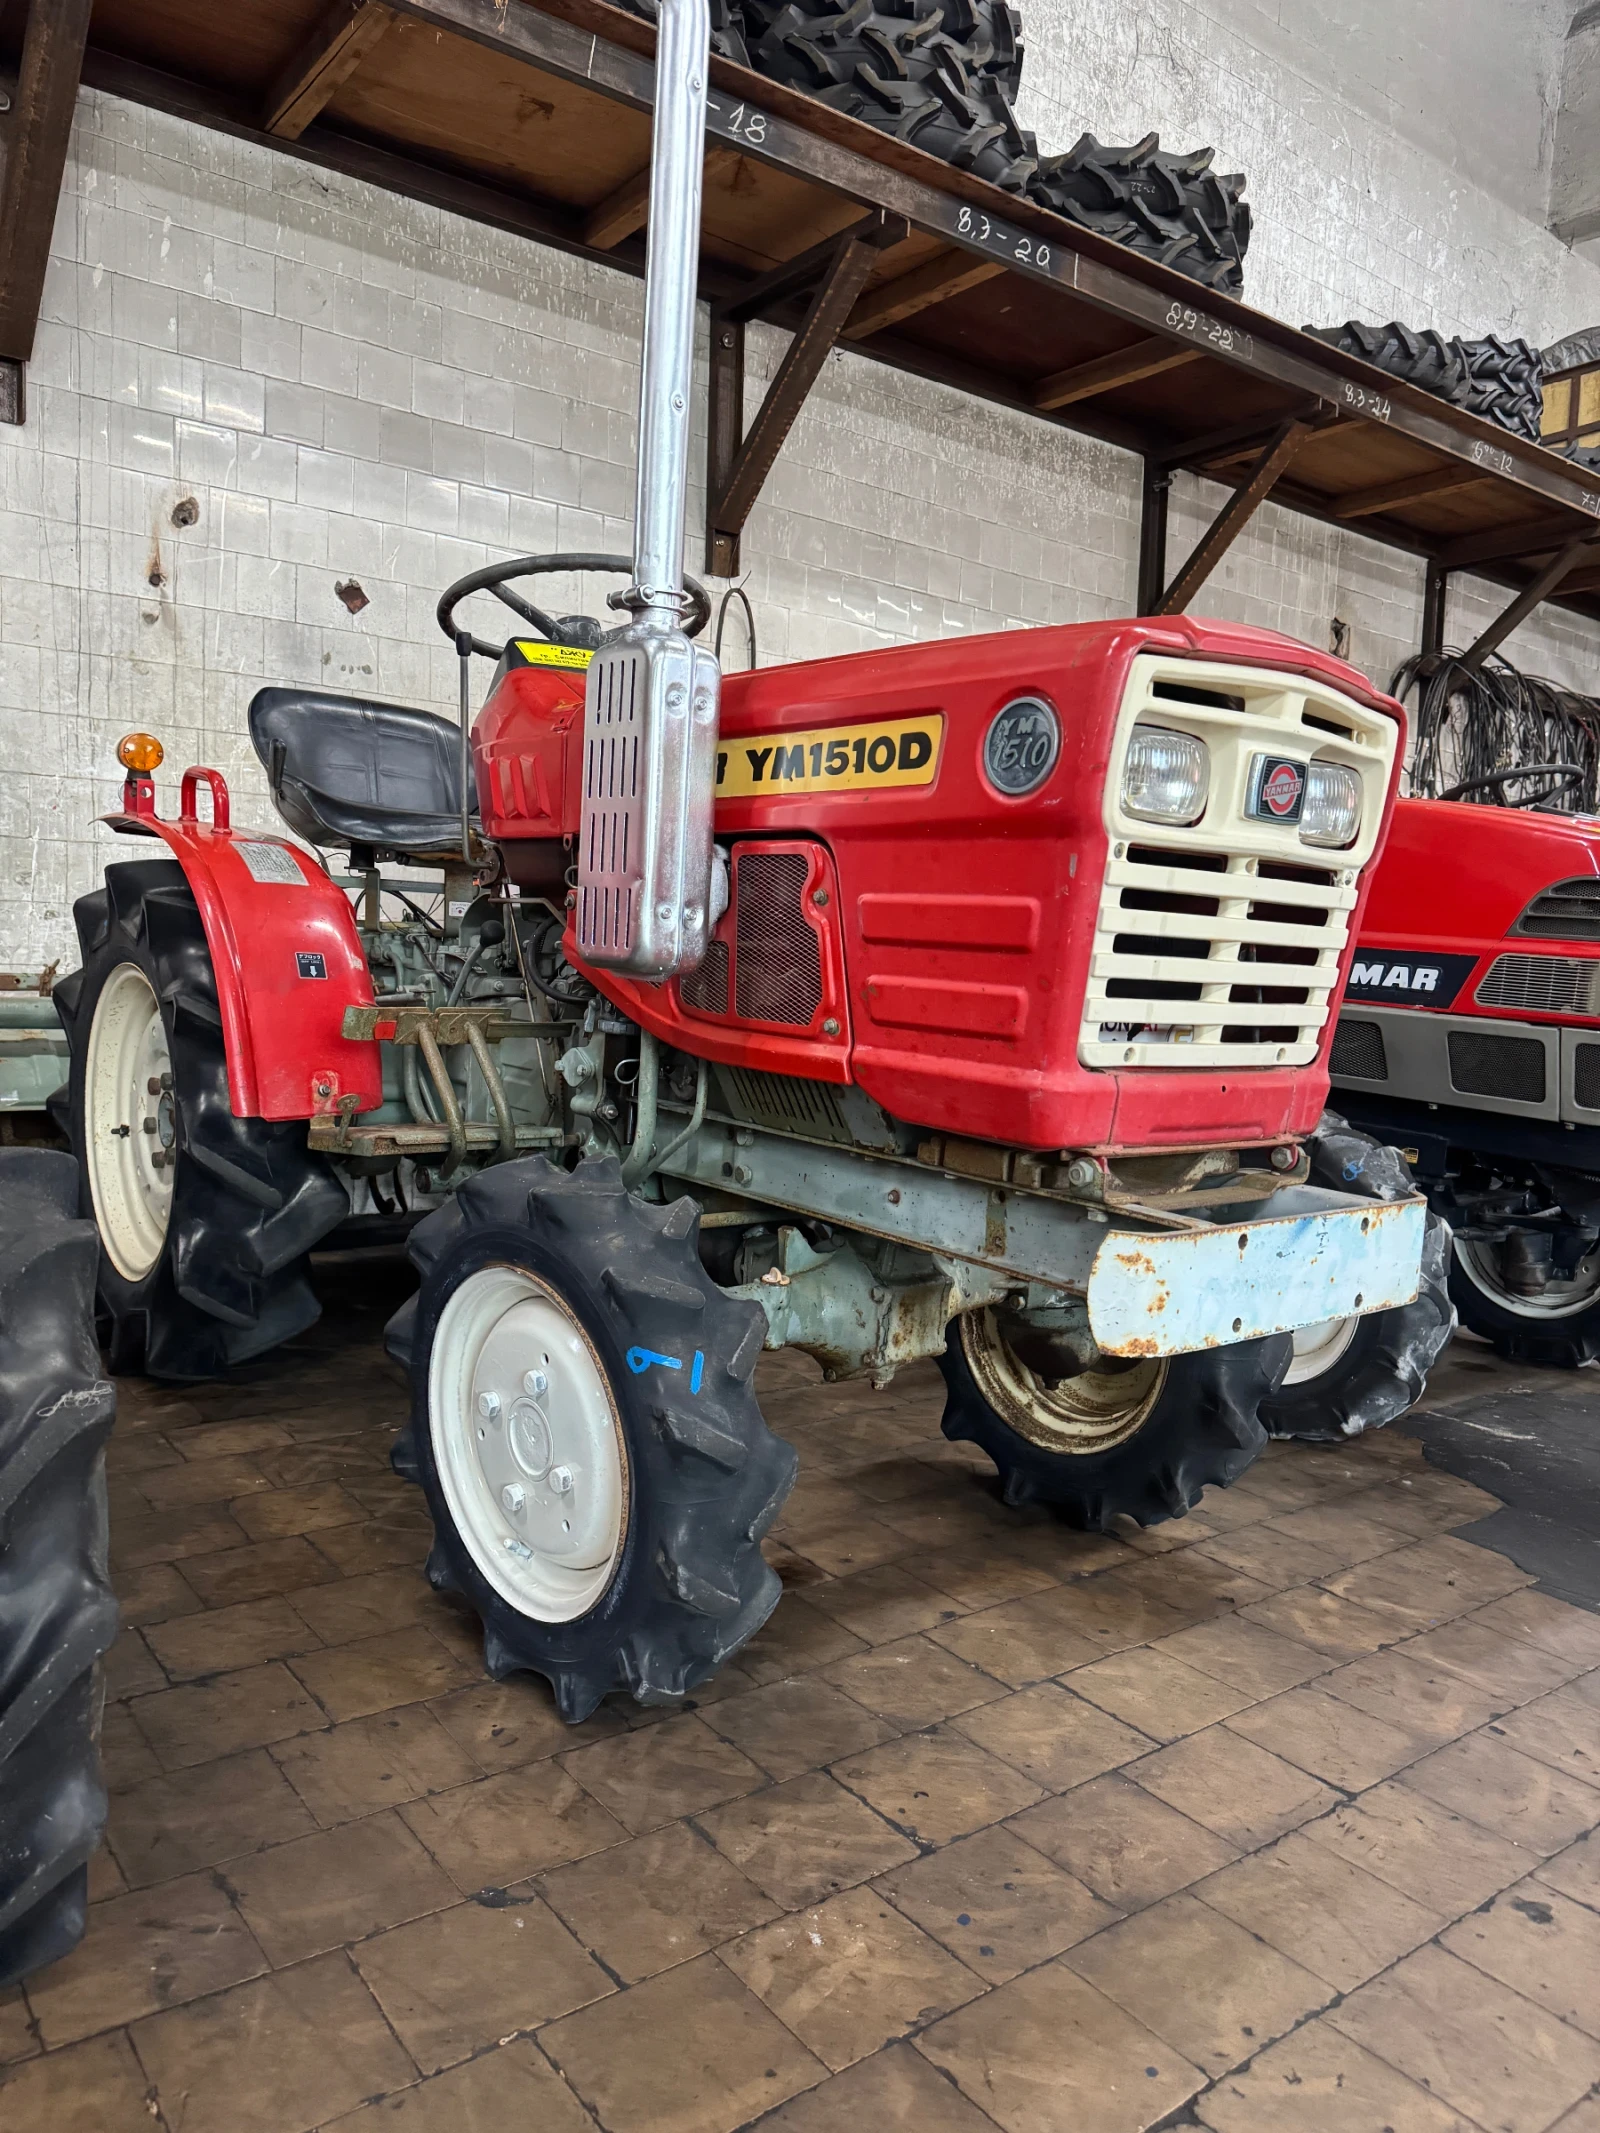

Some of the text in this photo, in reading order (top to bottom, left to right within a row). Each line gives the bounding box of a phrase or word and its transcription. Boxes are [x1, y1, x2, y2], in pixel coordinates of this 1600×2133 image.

[746, 731, 933, 783] YM1510D
[992, 734, 1049, 770] 1510
[1266, 782, 1301, 798] YANMAR
[1348, 963, 1440, 992] MAR
